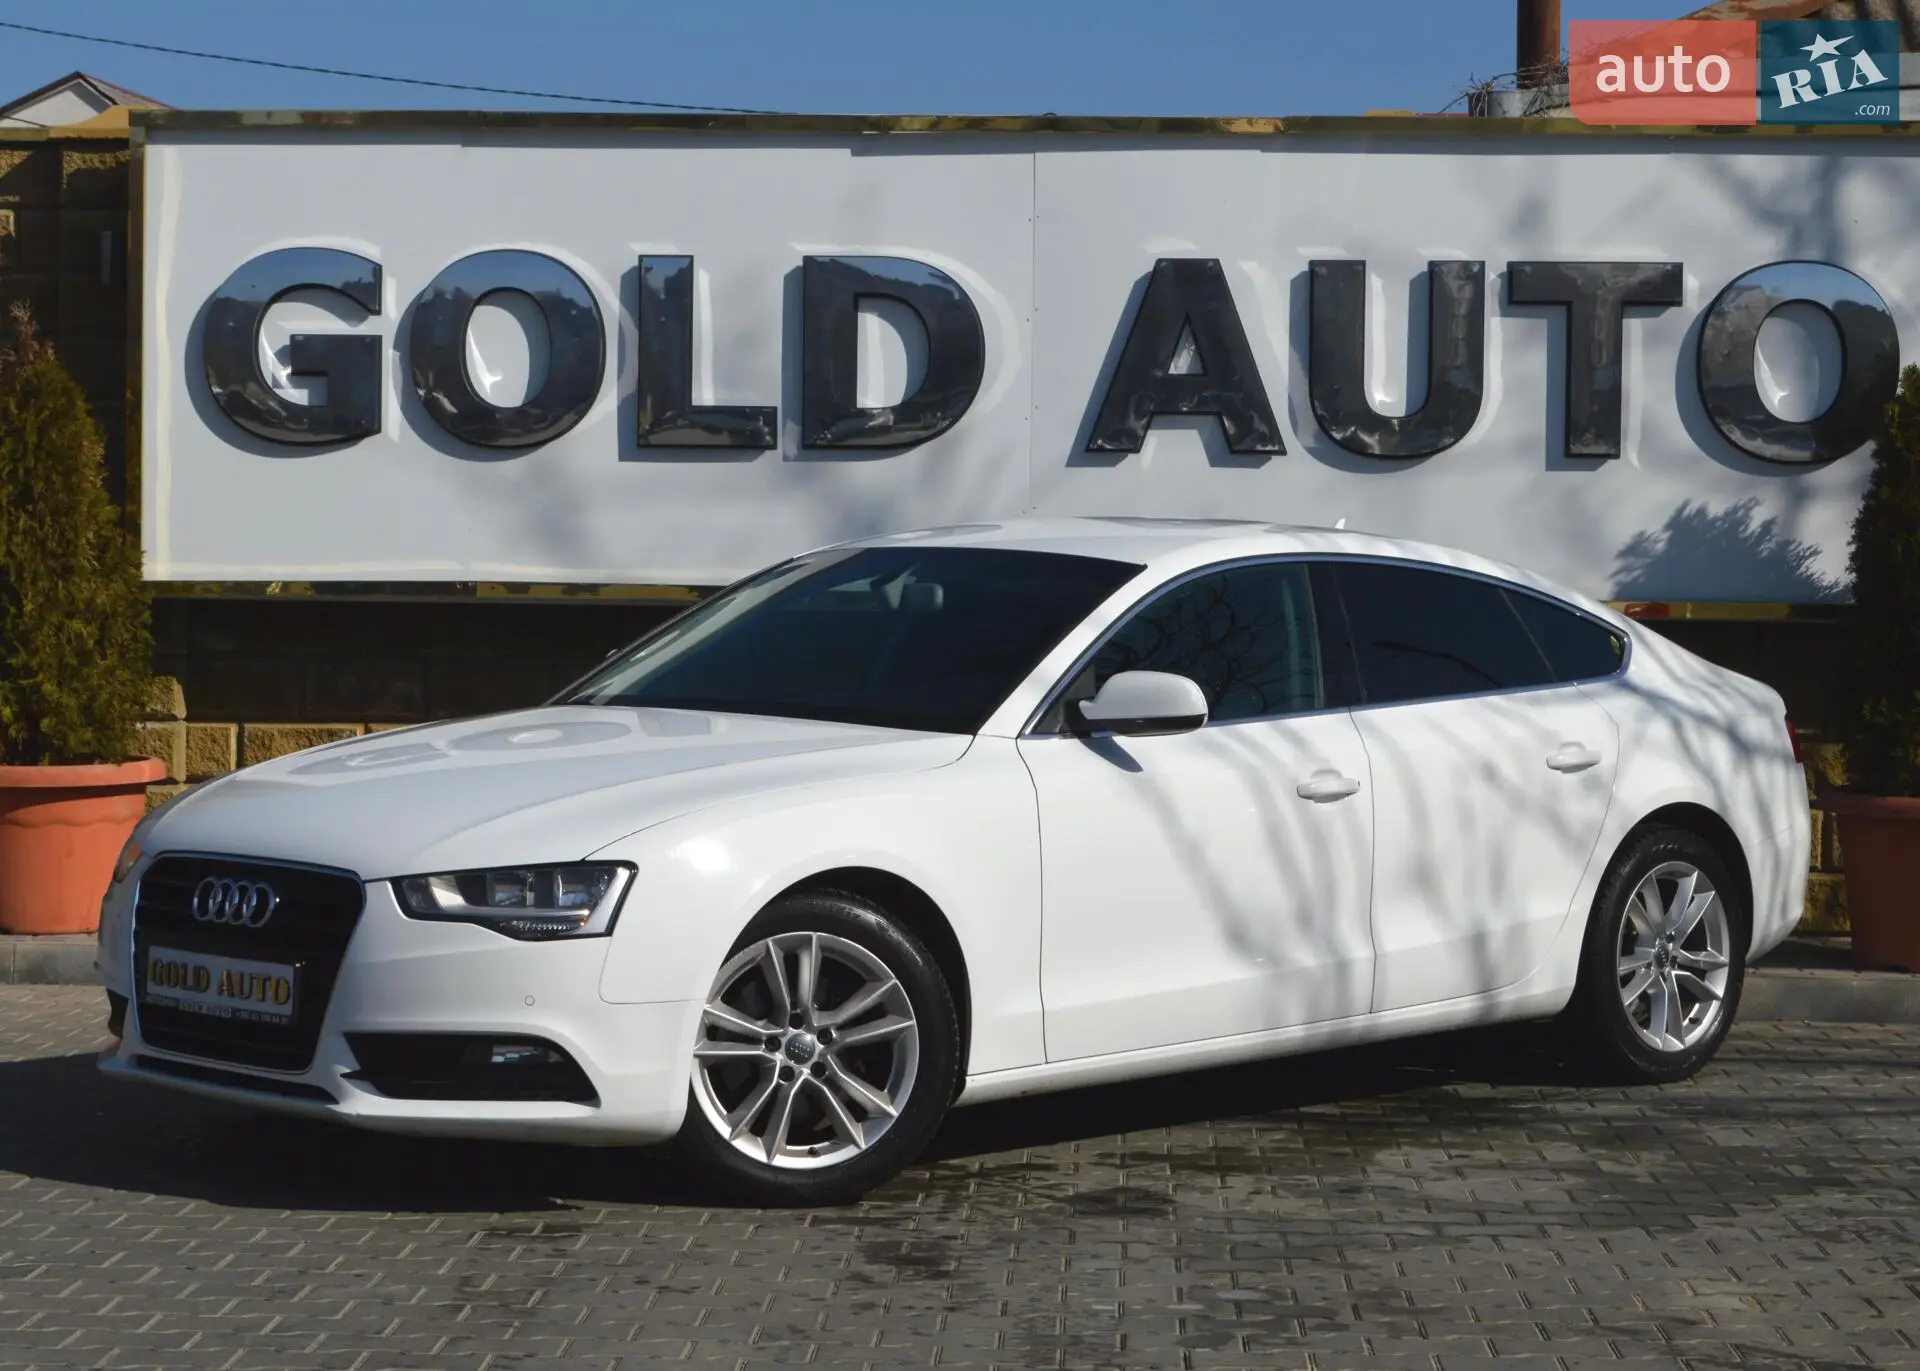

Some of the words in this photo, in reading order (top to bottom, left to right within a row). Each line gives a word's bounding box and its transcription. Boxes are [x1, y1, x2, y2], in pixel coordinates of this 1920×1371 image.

[204, 246, 987, 449] GOLD
[1085, 258, 1900, 464] AUTO
[151, 958, 211, 993] GOLD
[216, 968, 291, 1005] AUTO
